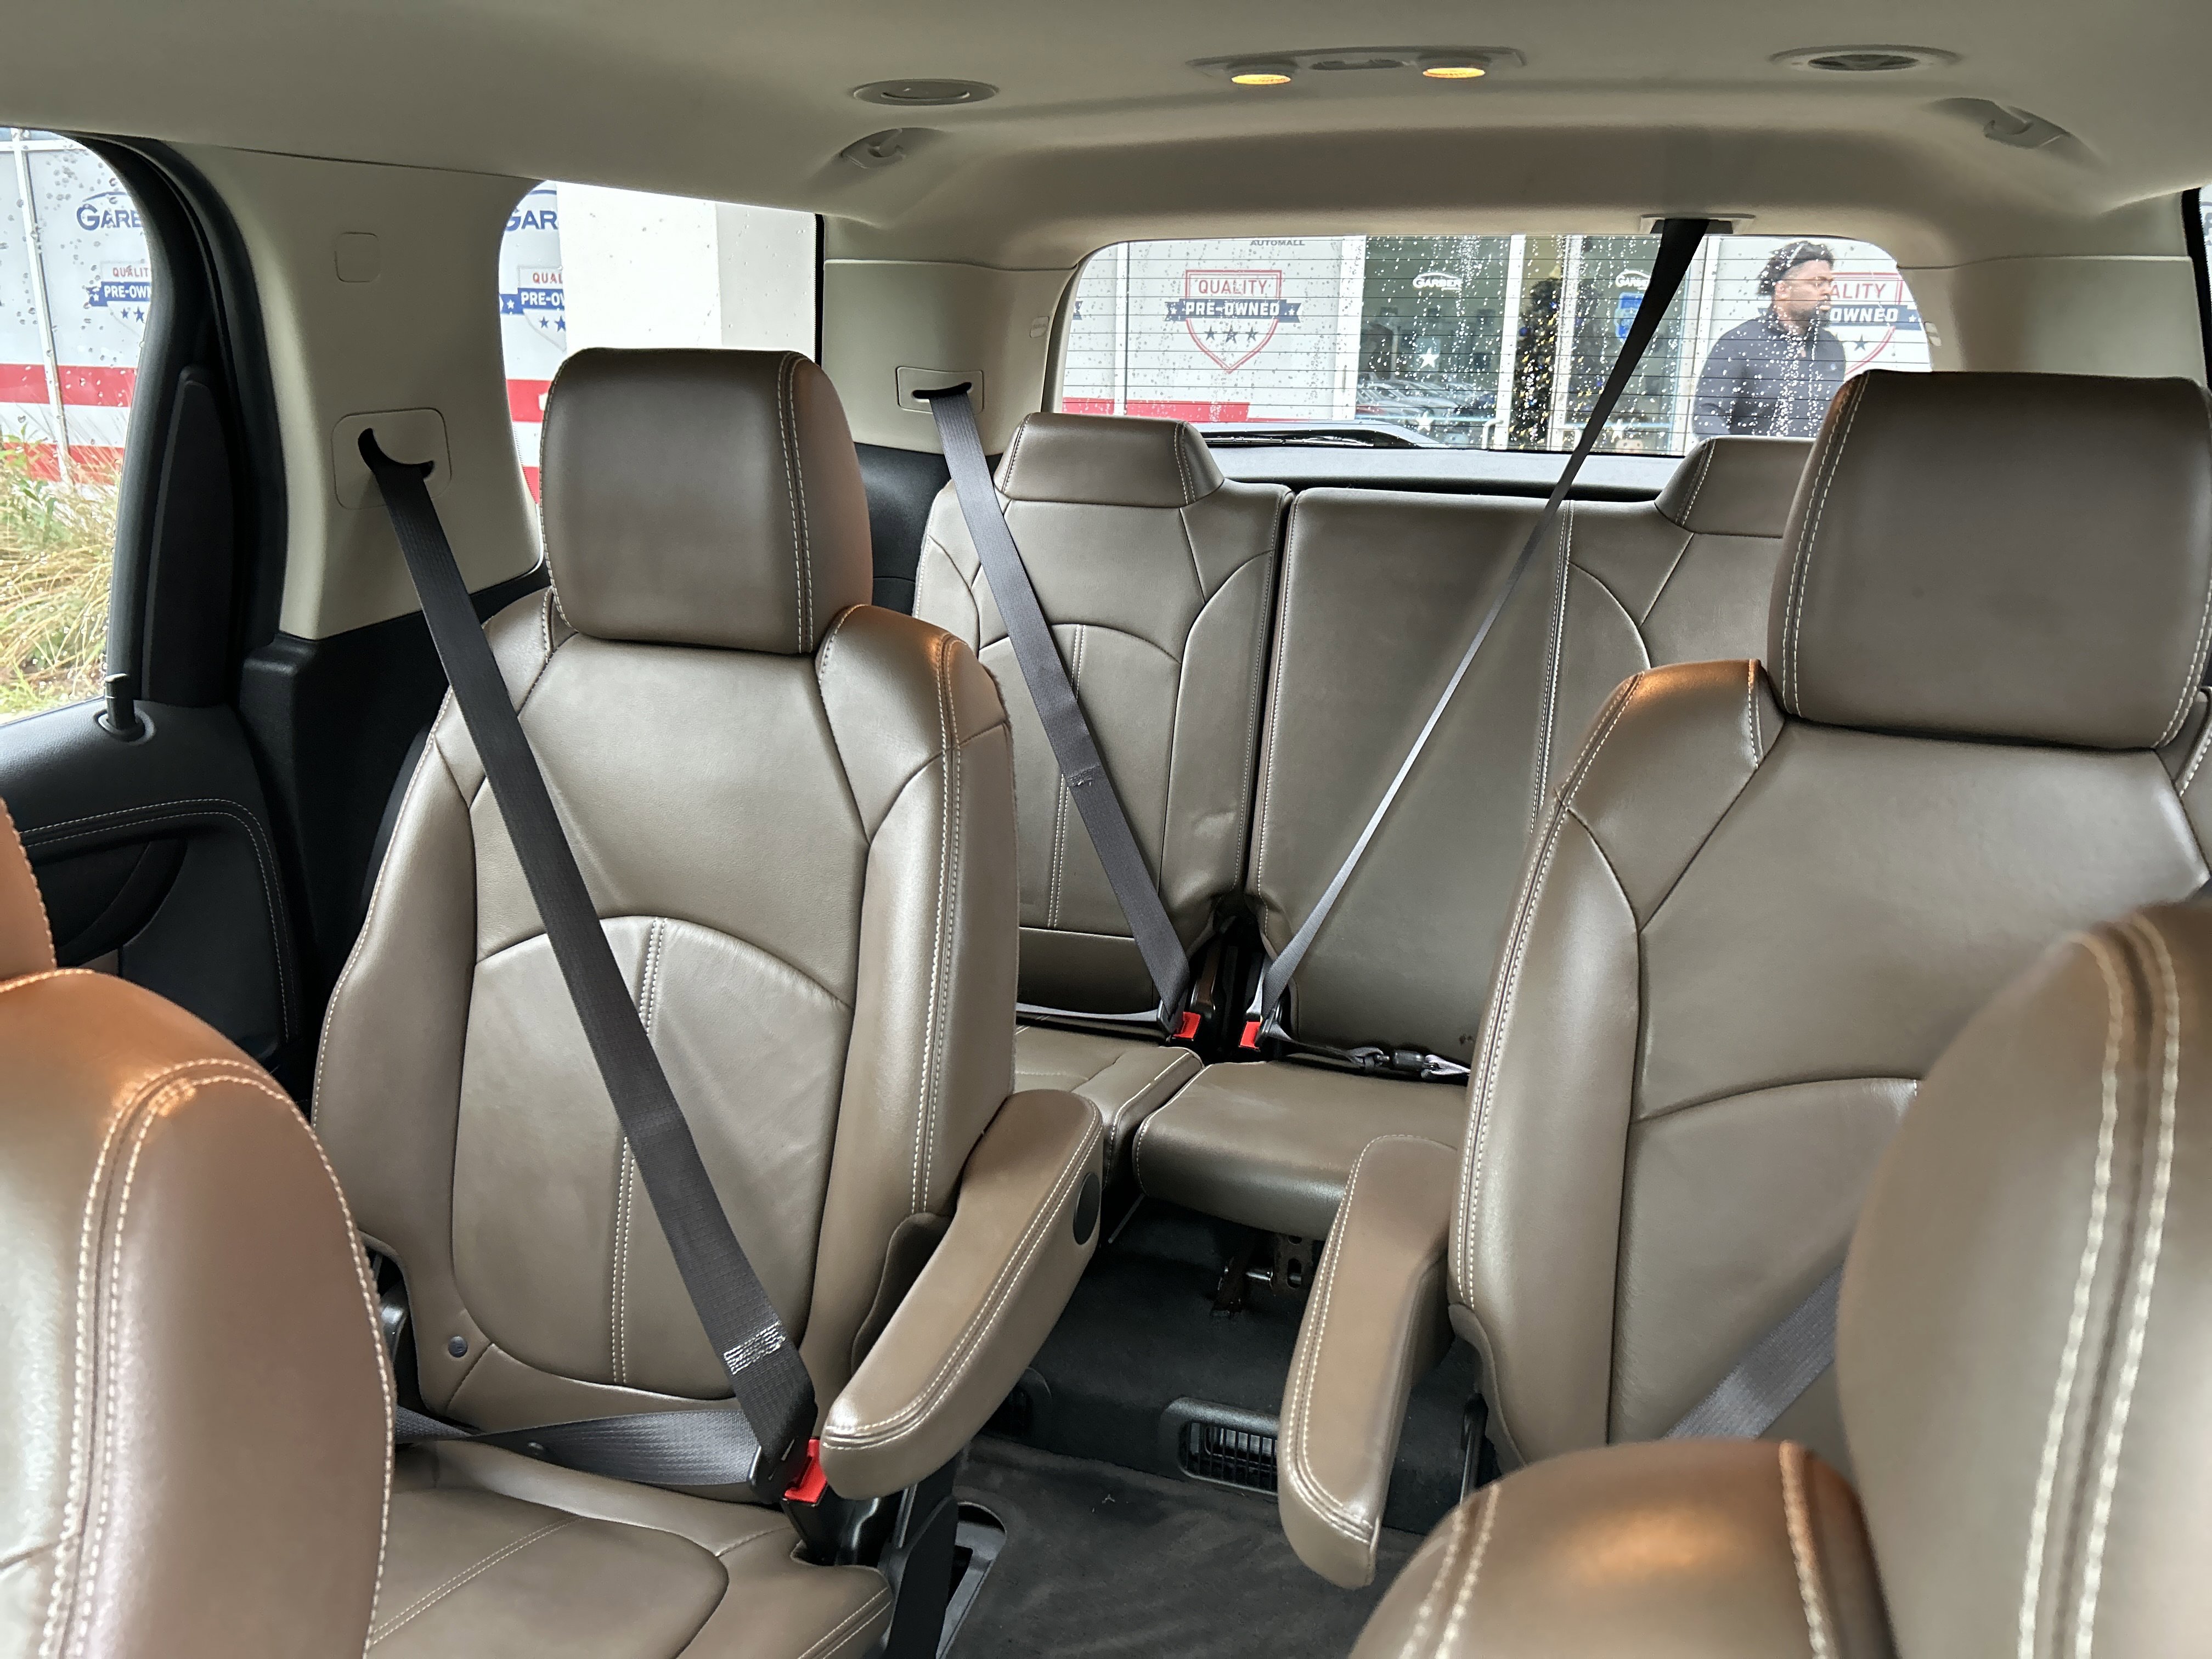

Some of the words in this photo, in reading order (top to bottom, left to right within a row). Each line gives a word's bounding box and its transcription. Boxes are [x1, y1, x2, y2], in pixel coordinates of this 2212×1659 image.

[77, 204, 142, 230] GARB
[113, 267, 149, 277] QUALIT
[533, 272, 562, 284] QUAL
[104, 285, 151, 298] PRE-OWN
[1199, 280, 1267, 295] QUALITY
[1830, 283, 1886, 299] ALITY
[1185, 302, 1279, 316] PRE-OWNED
[1830, 308, 1898, 323] OWNED
